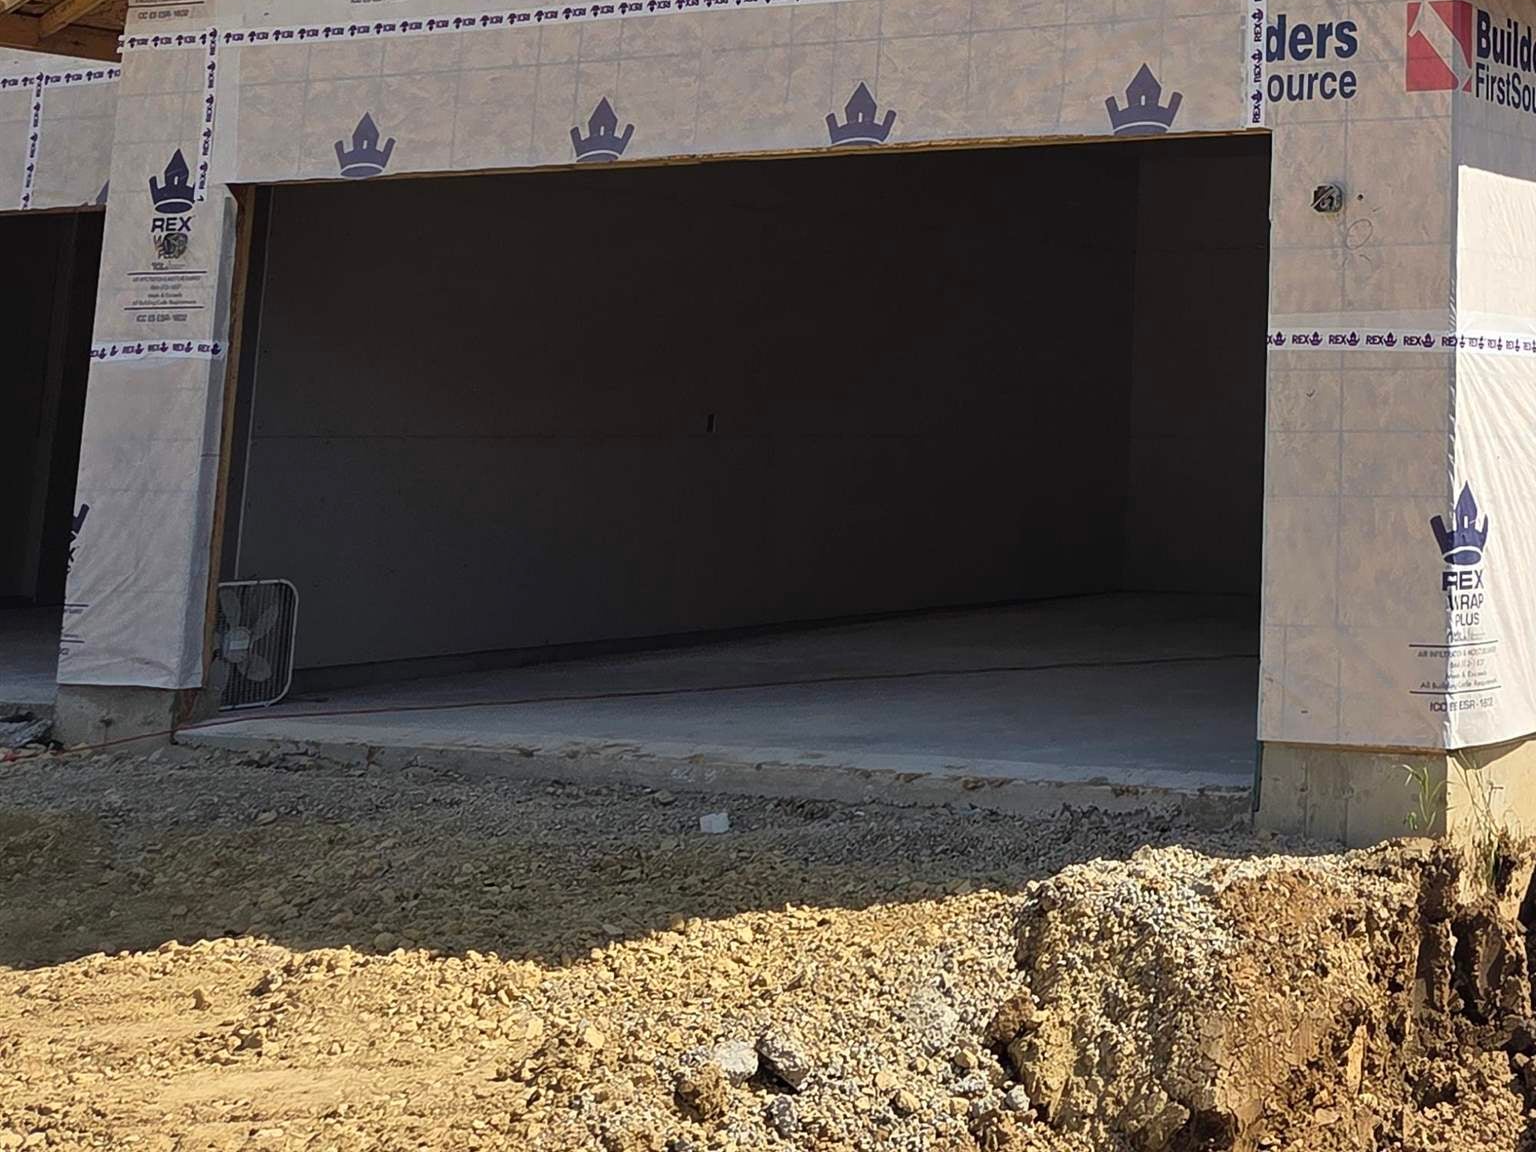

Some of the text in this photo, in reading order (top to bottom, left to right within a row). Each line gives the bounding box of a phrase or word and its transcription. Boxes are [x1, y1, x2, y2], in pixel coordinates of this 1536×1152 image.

[151, 216, 193, 233] REX
[1403, 335, 1422, 346] REX
[1442, 570, 1485, 592] REX
[1455, 612, 1480, 628] PLUS
